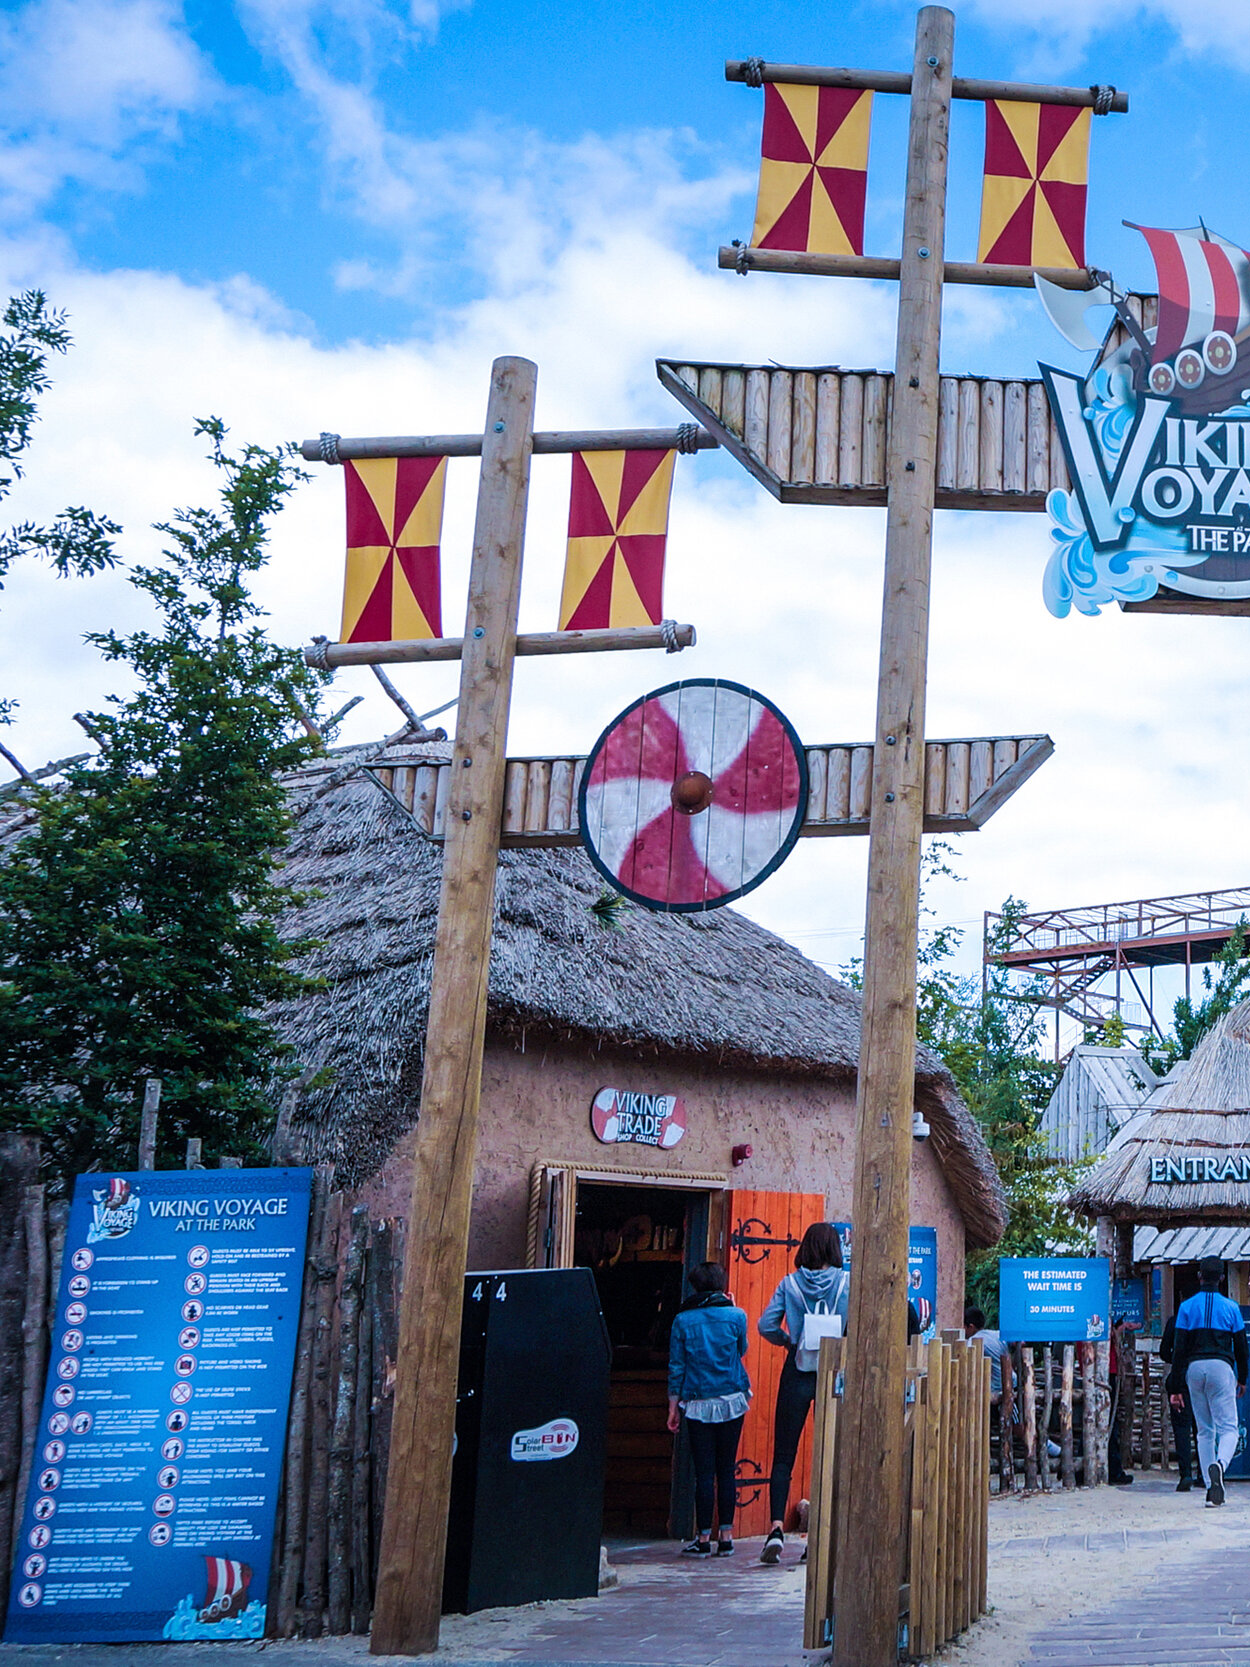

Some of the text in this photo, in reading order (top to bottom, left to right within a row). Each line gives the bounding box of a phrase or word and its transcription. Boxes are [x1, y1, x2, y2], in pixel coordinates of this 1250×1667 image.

[1186, 525, 1234, 552] THE
[616, 1091, 666, 1116] VIKING
[617, 1112, 662, 1135] TRADE
[149, 1198, 288, 1217] VIKING VOYAGE
[175, 1218, 256, 1231] AT THE PARK
[1023, 1270, 1087, 1280] THE ESTIMATED
[472, 1281, 483, 1301] 4
[496, 1281, 507, 1301] 4
[1027, 1282, 1083, 1291] WAIT TIME IS
[1030, 1305, 1075, 1314] 30 MINUTES
